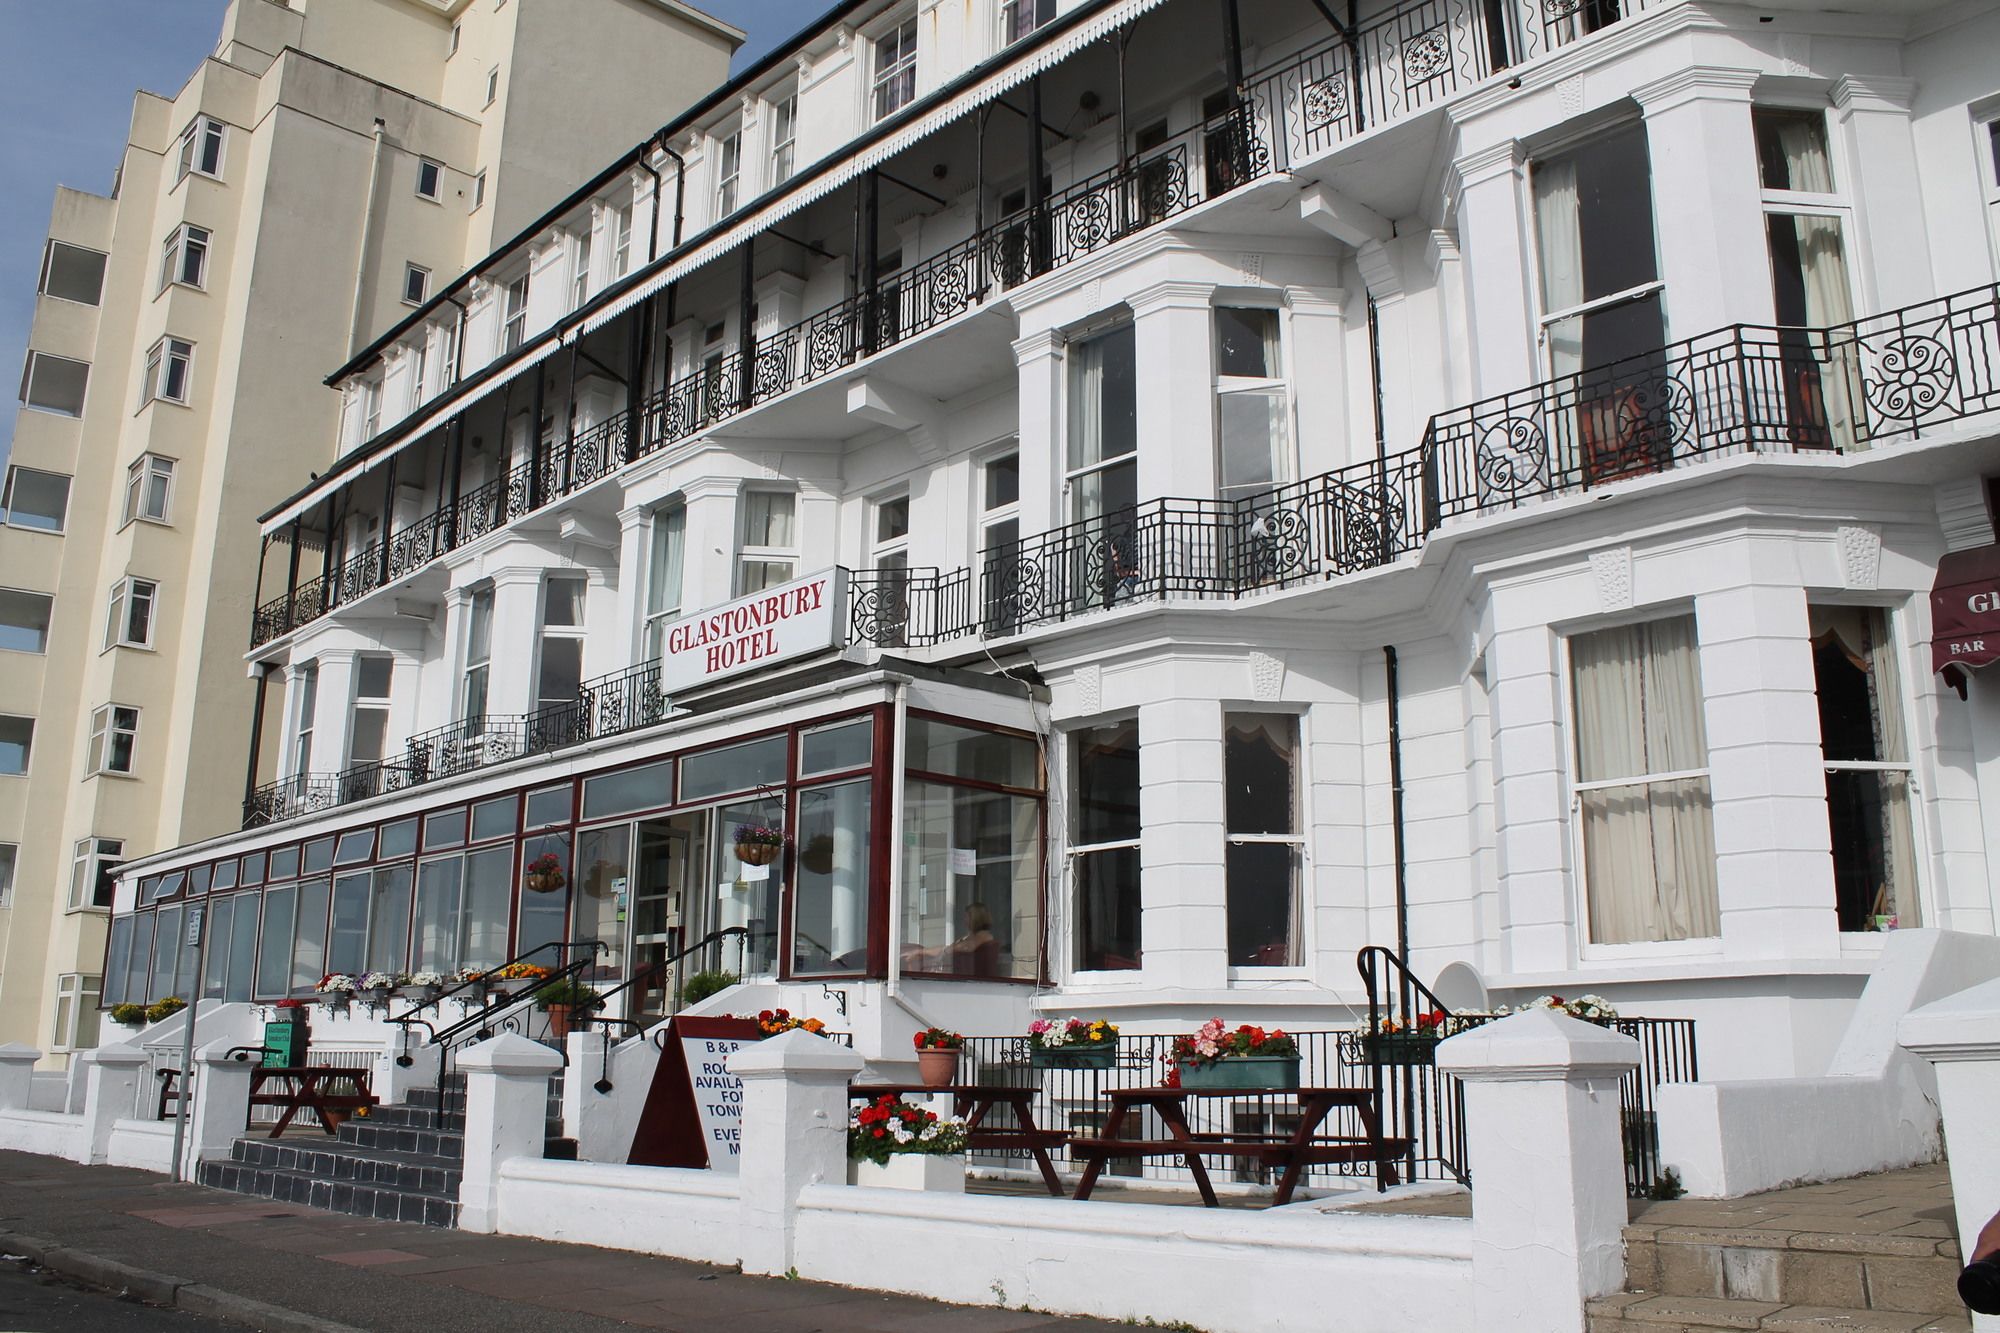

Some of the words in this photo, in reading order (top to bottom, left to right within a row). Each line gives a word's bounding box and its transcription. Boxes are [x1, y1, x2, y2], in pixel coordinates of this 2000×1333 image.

[669, 580, 826, 654] GLASTONBURY
[705, 628, 779, 674] HOTEL
[1950, 640, 1985, 655] BAR
[706, 1041, 715, 1053] B
[718, 1041, 729, 1053] &
[706, 1104, 743, 1117] TONI
[713, 1128, 741, 1141] EVE
